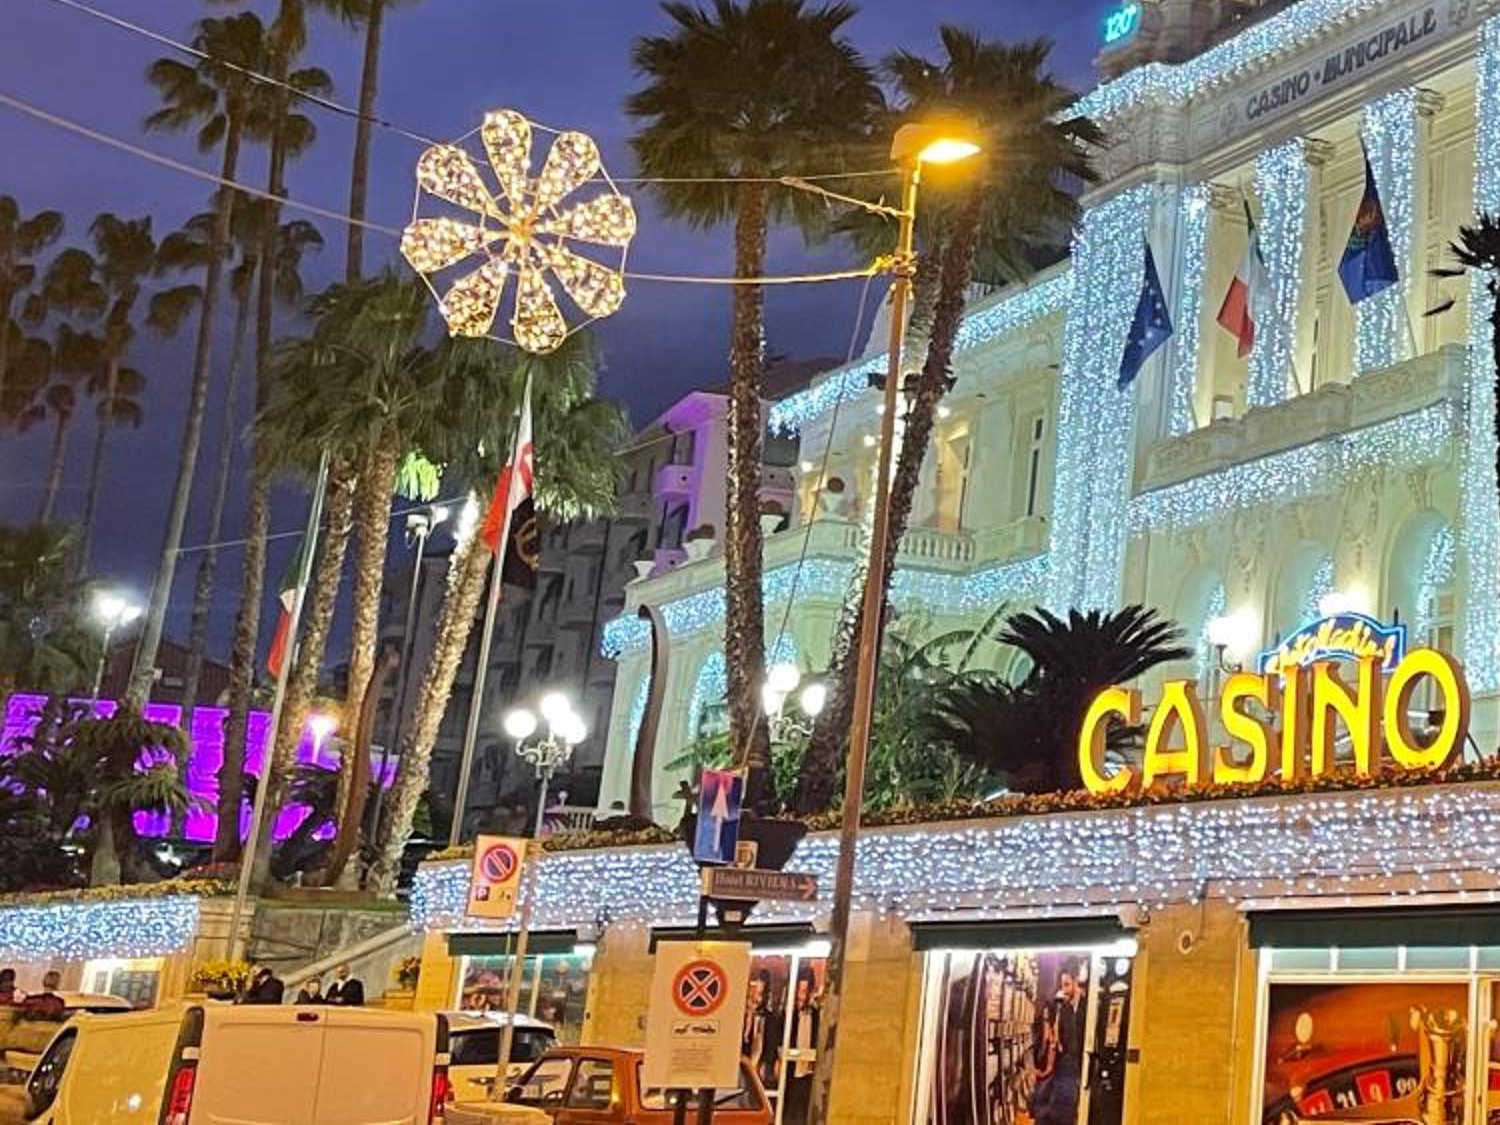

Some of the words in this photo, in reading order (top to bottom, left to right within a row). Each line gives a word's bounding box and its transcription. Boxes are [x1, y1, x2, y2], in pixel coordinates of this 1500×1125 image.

[1247, 71, 1310, 119] CASINO
[1322, 8, 1436, 85] MUNICIPALE
[1079, 648, 1466, 794] CASINO
